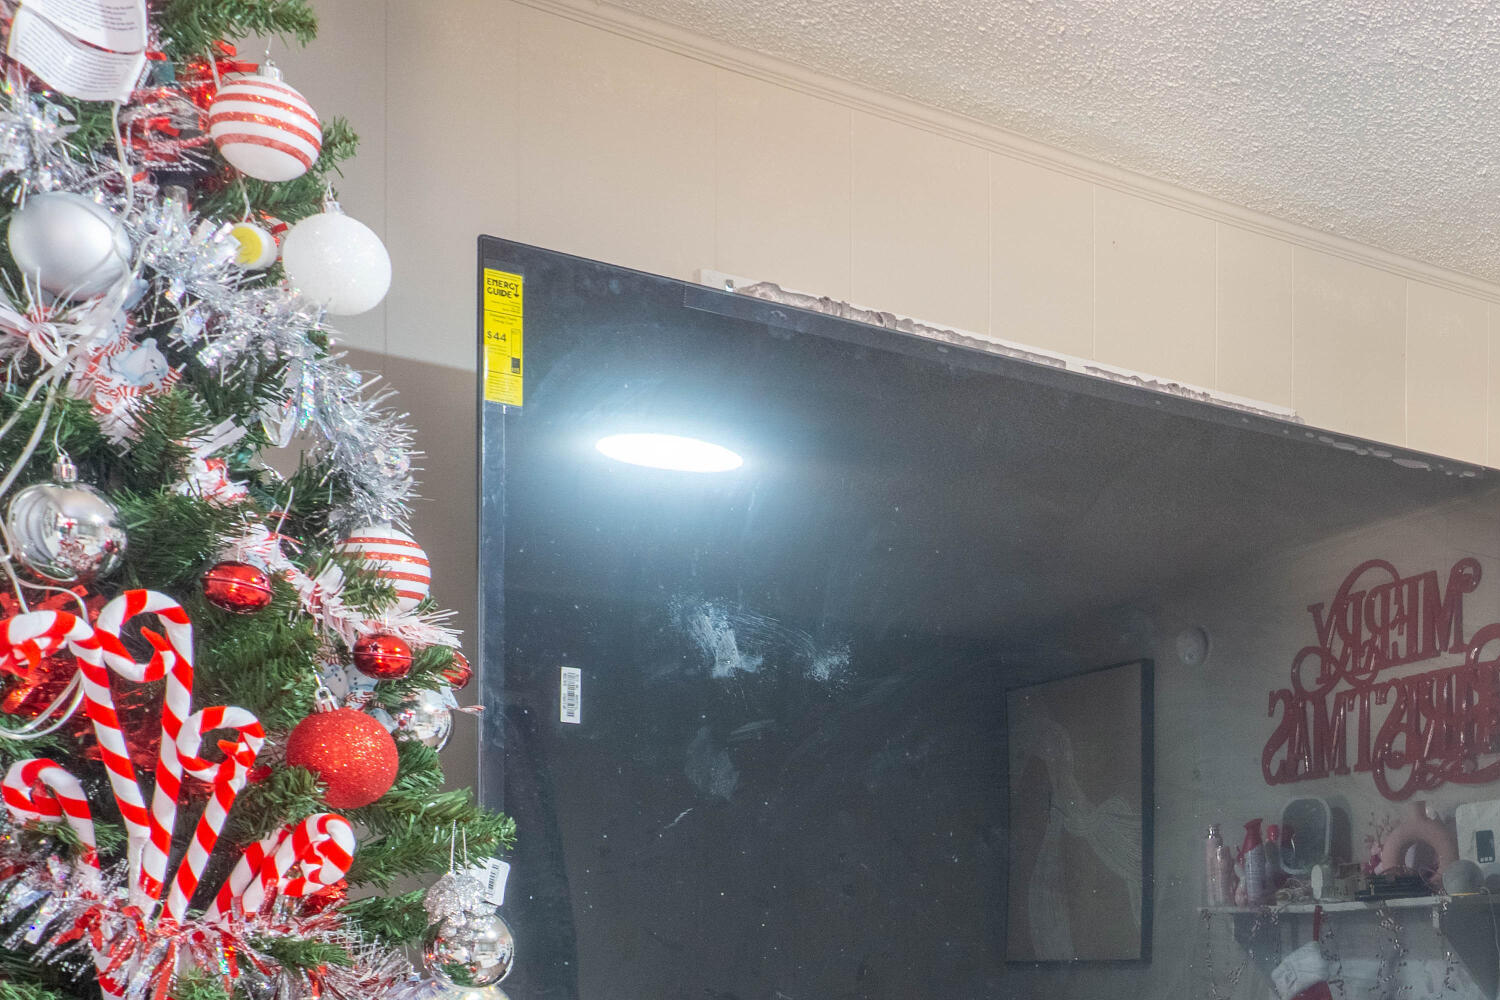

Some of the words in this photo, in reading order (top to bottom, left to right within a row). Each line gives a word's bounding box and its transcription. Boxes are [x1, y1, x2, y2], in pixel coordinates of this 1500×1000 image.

[487, 278, 519, 292] ENERGY
[487, 286, 513, 299] GUIDE
[487, 330, 507, 342] $44
